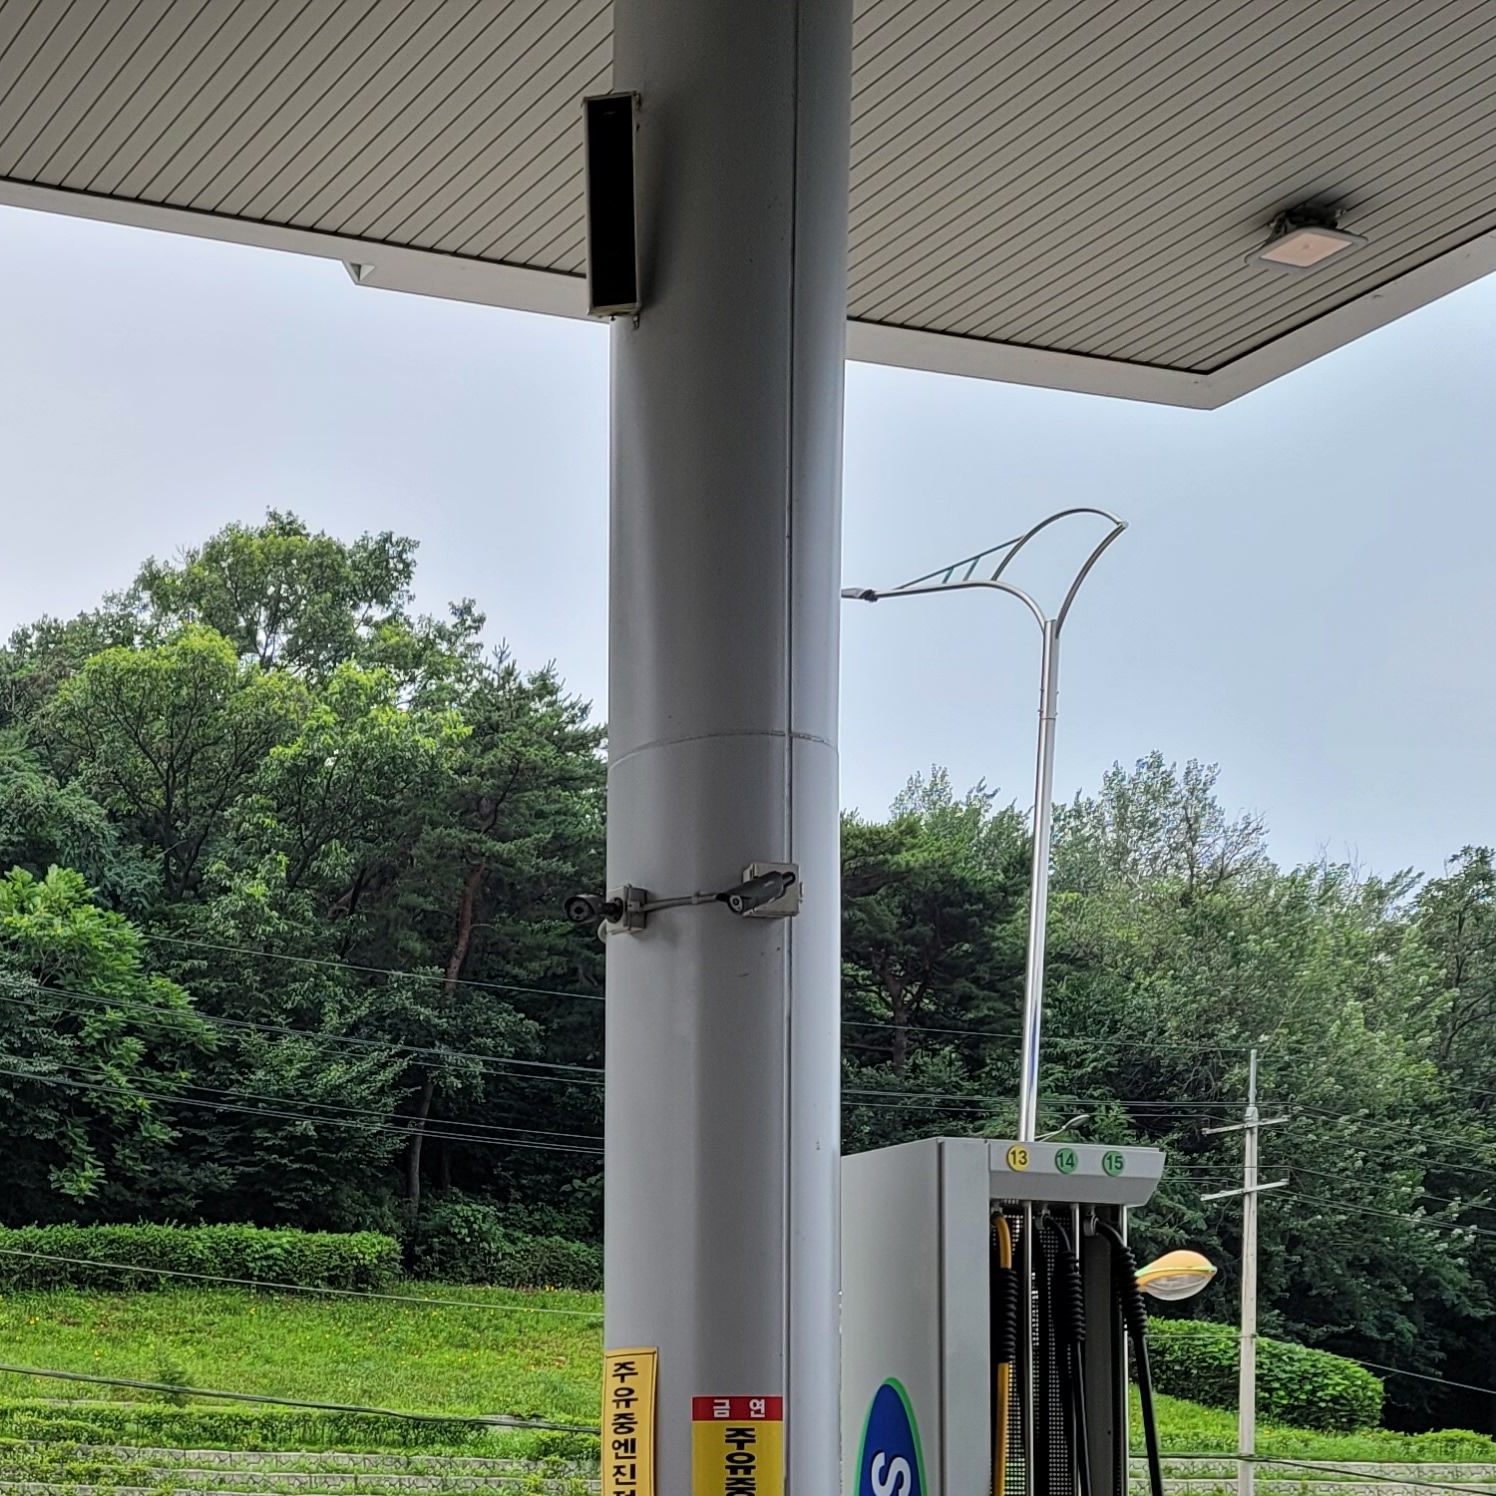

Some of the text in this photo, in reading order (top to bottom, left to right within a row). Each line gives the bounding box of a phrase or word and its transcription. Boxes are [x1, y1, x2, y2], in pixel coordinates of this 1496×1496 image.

[1011, 1151, 1028, 1166] 13
[1057, 1153, 1075, 1169] 14
[1107, 1155, 1123, 1170] 15
[712, 1398, 766, 1418] 금연
